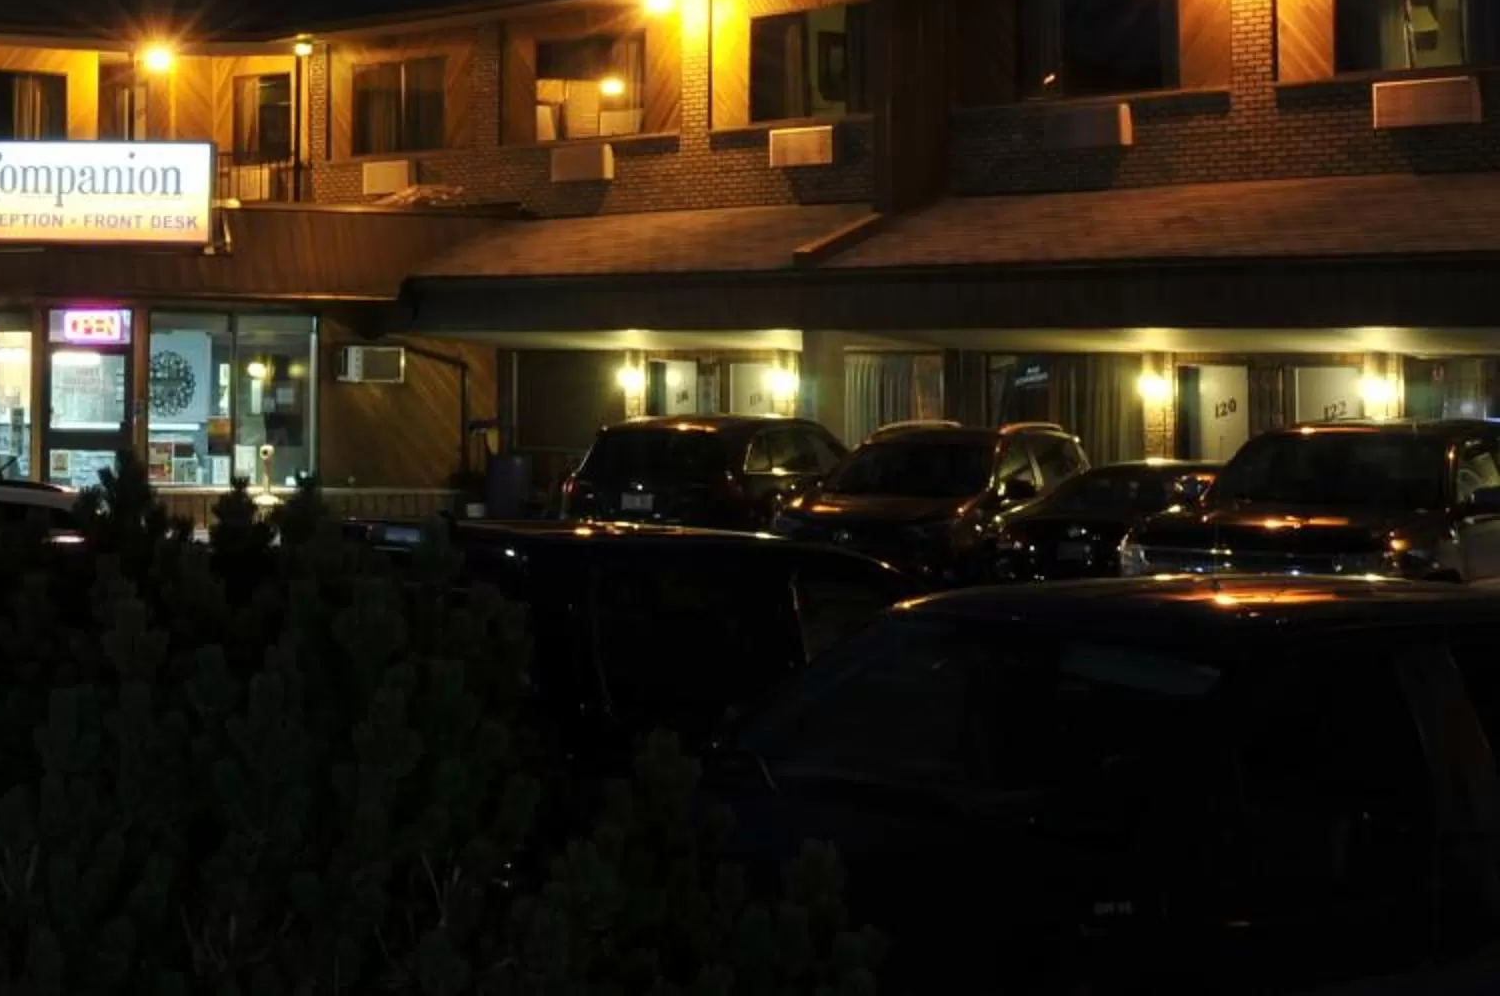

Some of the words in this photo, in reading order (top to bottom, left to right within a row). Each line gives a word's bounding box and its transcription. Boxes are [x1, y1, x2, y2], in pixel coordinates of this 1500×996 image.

[83, 213, 143, 229] FRONT
[151, 214, 199, 230] DESK
[1214, 397, 1238, 420] 120
